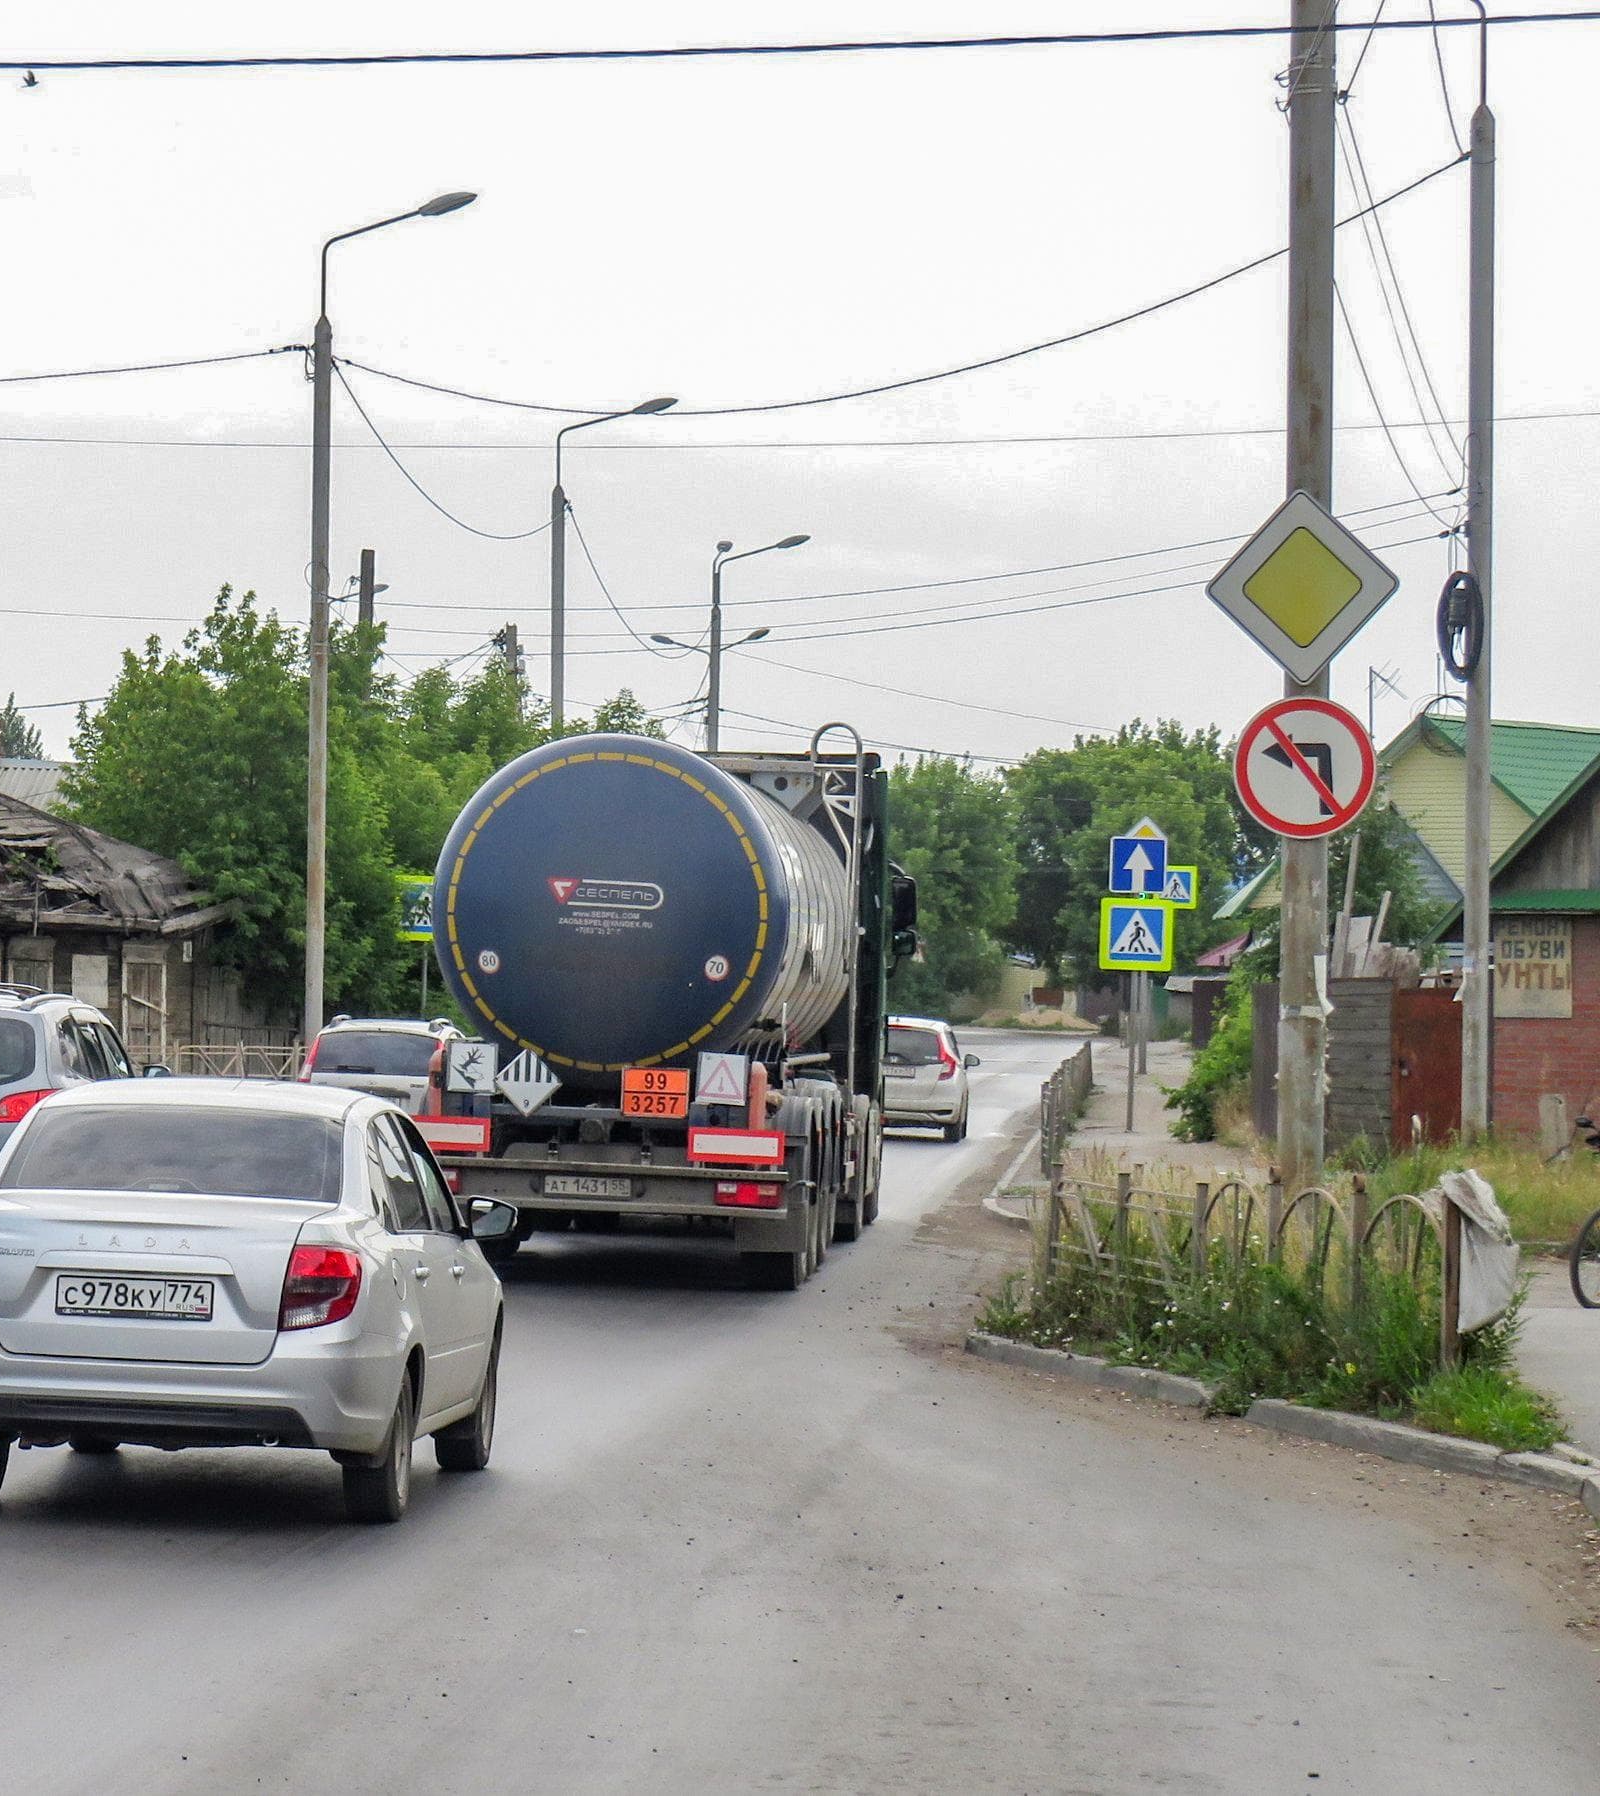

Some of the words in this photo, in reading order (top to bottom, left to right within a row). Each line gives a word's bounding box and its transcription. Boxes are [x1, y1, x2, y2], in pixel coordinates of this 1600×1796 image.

[1501, 940, 1565, 960] ОБУВИ
[481, 954, 496, 967] 80
[708, 961, 725, 974] 70
[1497, 962, 1571, 991] УНТЫ
[644, 1072, 667, 1089] 99
[523, 1099, 529, 1108] 9
[630, 1095, 679, 1115] 3257
[78, 1232, 191, 1250] LADA
[175, 1303, 195, 1311] RUS
